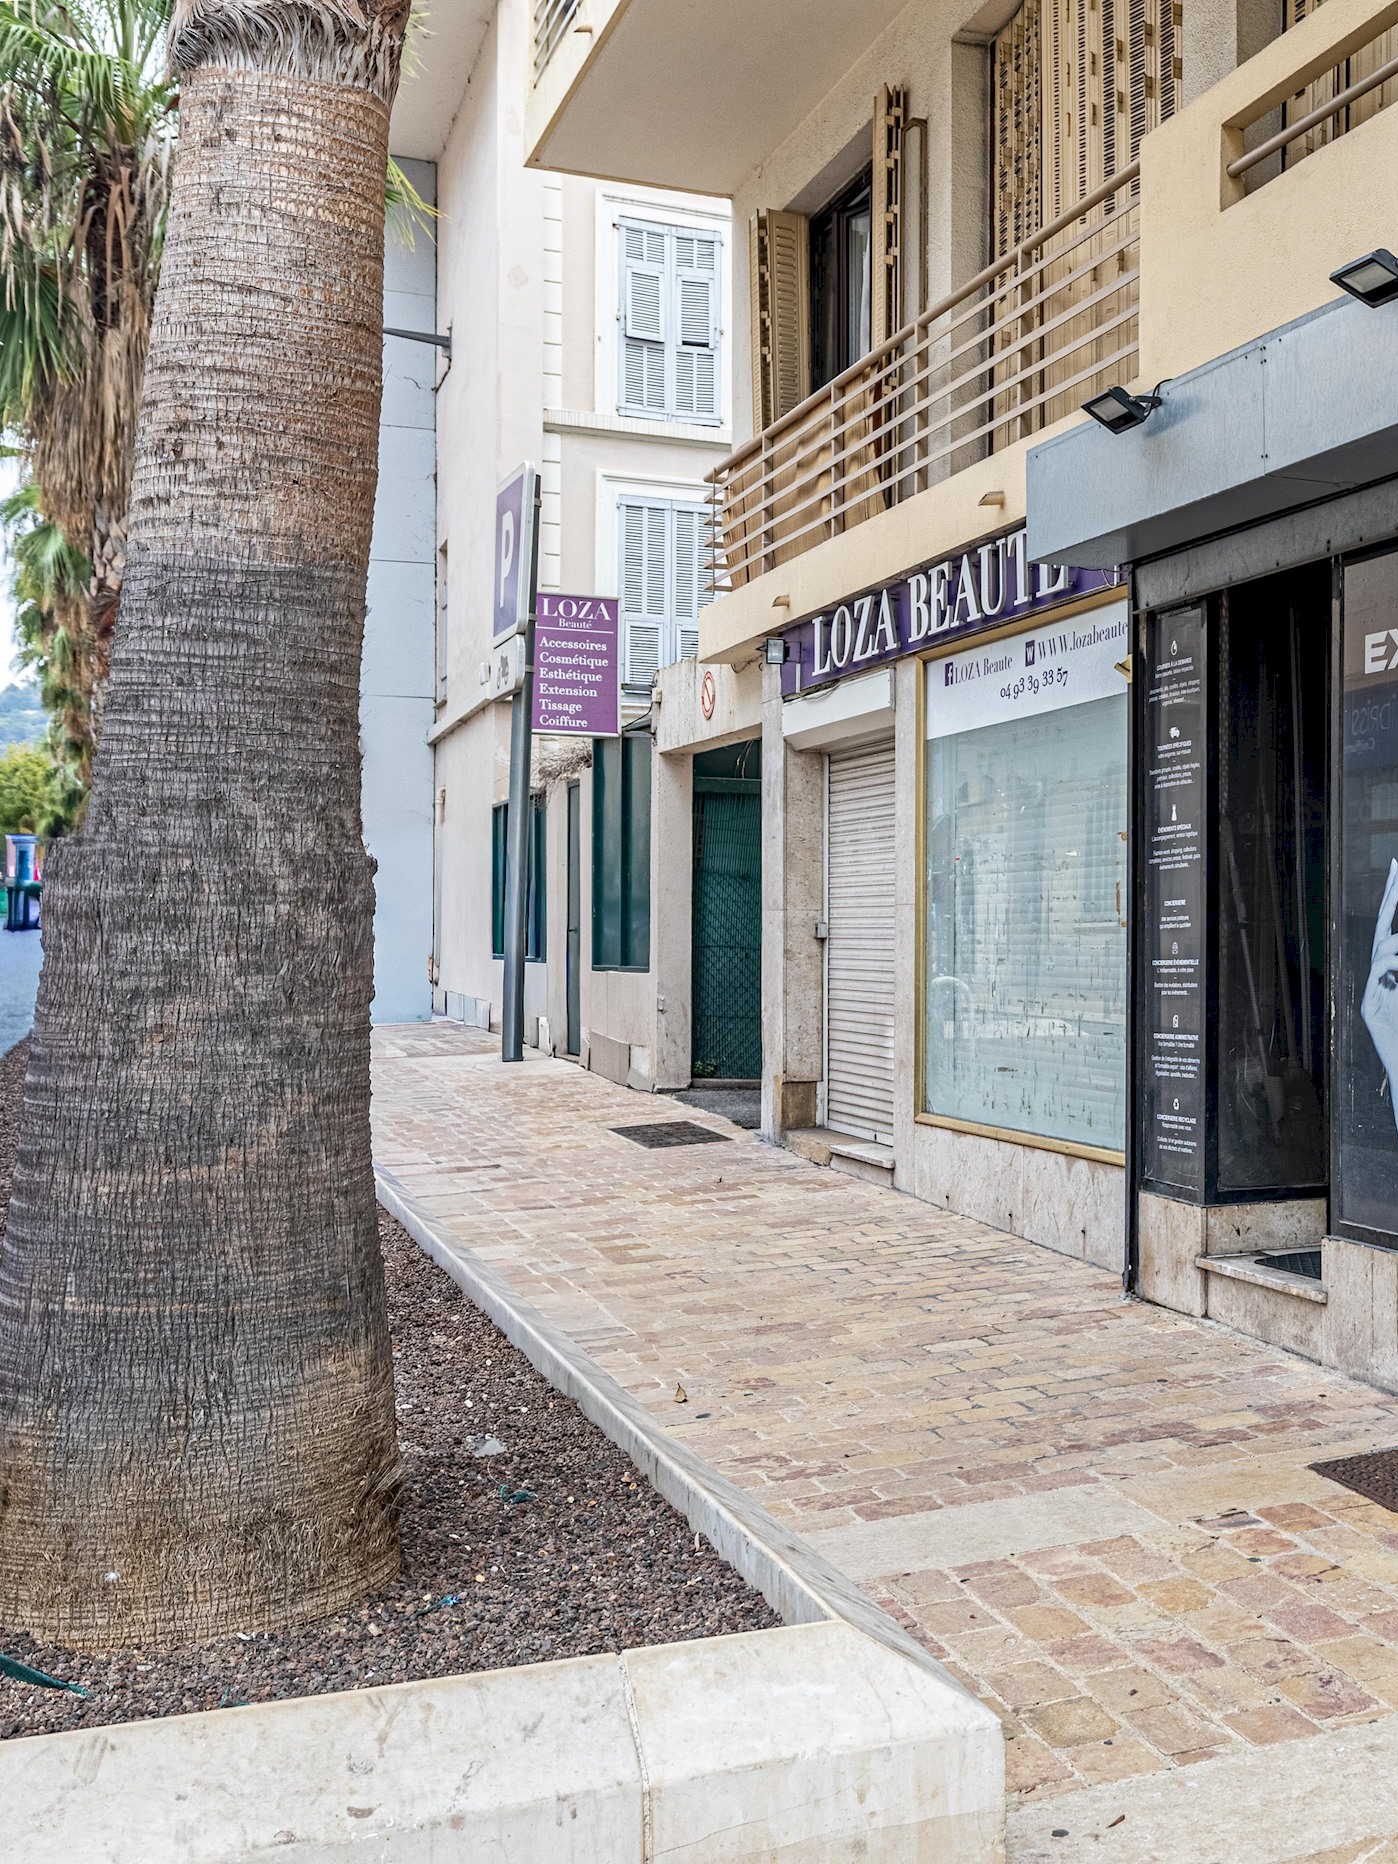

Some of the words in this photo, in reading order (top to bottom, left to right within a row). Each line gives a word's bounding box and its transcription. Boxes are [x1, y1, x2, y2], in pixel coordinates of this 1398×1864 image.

[500, 510, 515, 608] P
[541, 597, 612, 621] LOZA
[559, 618, 592, 630] Beauté
[811, 588, 899, 677] LOZA
[539, 636, 607, 651] Accessoires
[539, 652, 609, 669] Cosmétique
[538, 667, 603, 684] Esthétique
[955, 662, 982, 683] LOZA
[983, 656, 1013, 677] Beaute
[538, 683, 598, 697] Extension
[1000, 682, 1011, 699] 04
[1013, 677, 1025, 699] 93
[1027, 675, 1039, 694] 39
[1042, 669, 1054, 687] 33
[1056, 666, 1068, 686] 57
[538, 698, 583, 715] Tissage
[539, 714, 588, 728] Coiffure
